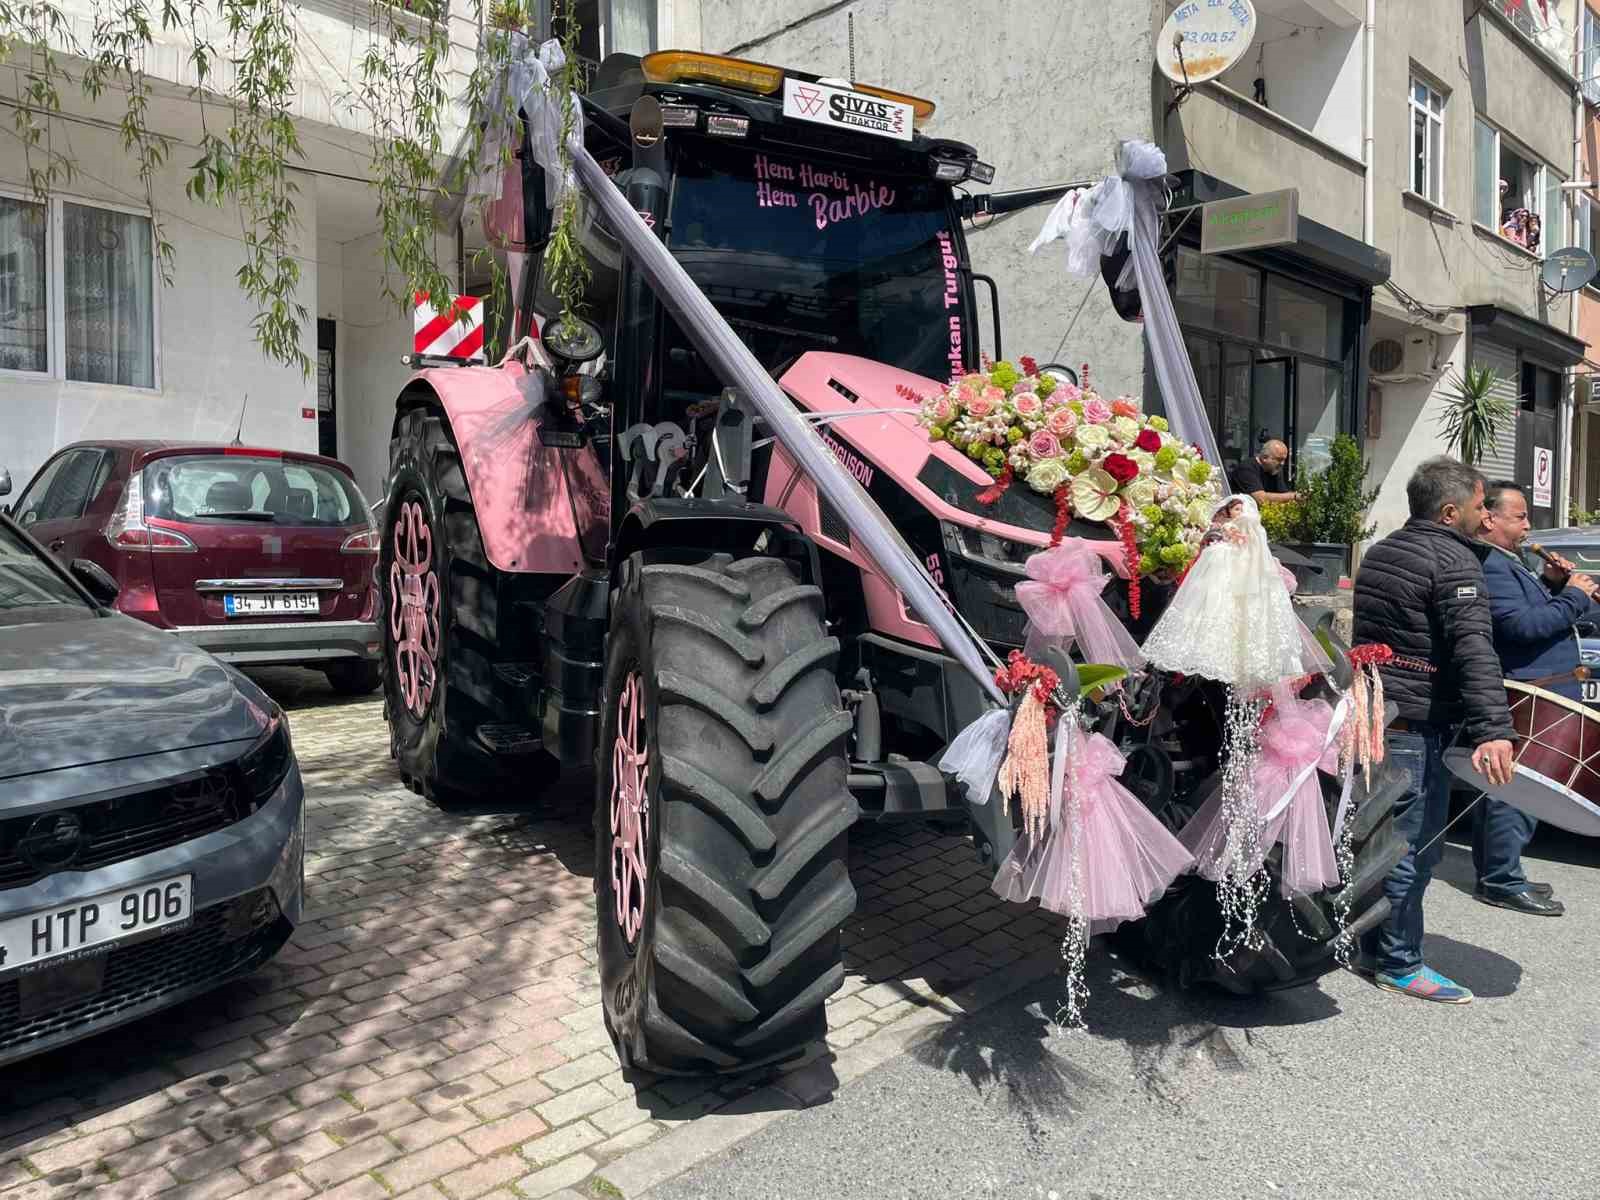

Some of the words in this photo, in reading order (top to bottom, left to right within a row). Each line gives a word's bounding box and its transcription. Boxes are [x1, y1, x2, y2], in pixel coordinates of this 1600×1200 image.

[845, 113, 889, 132] TRAKTOR
[754, 153, 795, 180] Hem
[799, 163, 849, 191] Harbi
[756, 181, 797, 208] Hem
[808, 180, 895, 230] Barbie
[937, 231, 958, 309] Turgut
[235, 594, 251, 609] 34
[260, 594, 275, 609] JV
[282, 594, 316, 609] 6194
[31, 903, 99, 957] HTP
[120, 881, 182, 930] 906
